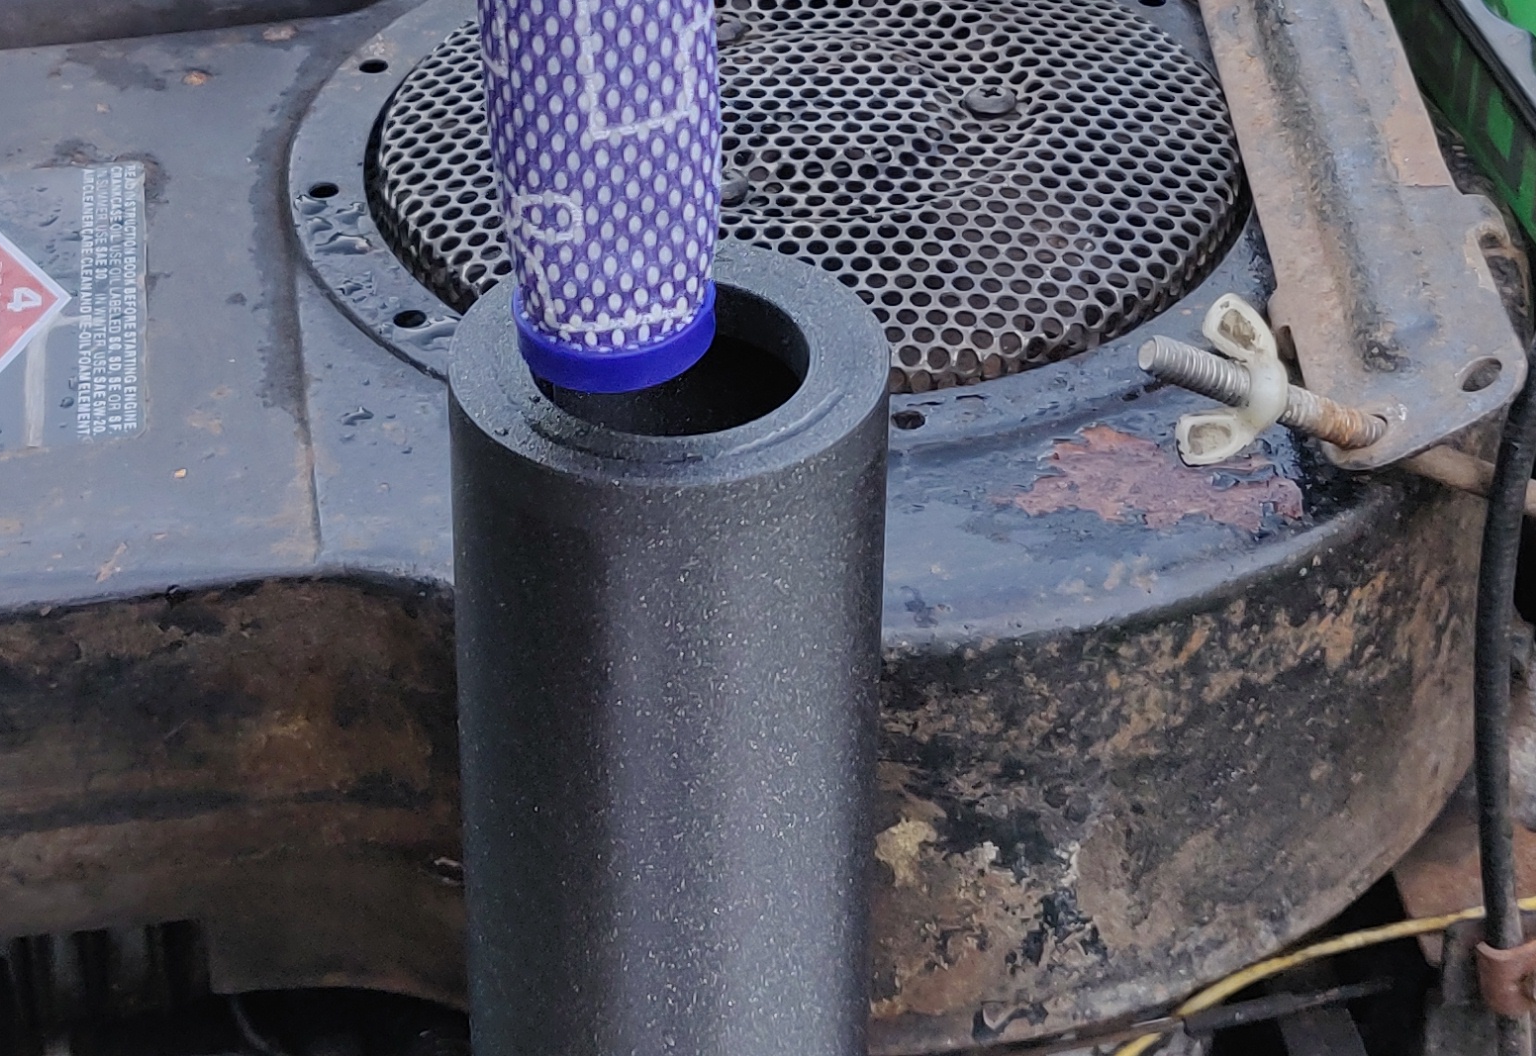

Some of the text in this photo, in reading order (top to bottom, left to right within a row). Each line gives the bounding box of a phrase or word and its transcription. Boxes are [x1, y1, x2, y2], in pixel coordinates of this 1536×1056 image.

[82, 184, 94, 228] CLEANER
[110, 166, 122, 223] CRANKCASE
[95, 225, 108, 244] USE
[124, 190, 136, 255] INSTRUCTION
[95, 246, 108, 265] SAE
[109, 245, 122, 265] USE
[109, 267, 122, 285] OIL
[124, 256, 136, 286] BOOK
[7, 287, 42, 313] 4
[79, 290, 92, 313] AND
[109, 286, 121, 333] LABELED
[124, 287, 136, 330] BEFORE
[78, 350, 91, 381] FOAM
[93, 351, 106, 374] USE
[124, 331, 137, 383] STARTING
[93, 376, 106, 398] SAE
[108, 376, 121, 391] SE
[108, 394, 121, 411] OR
